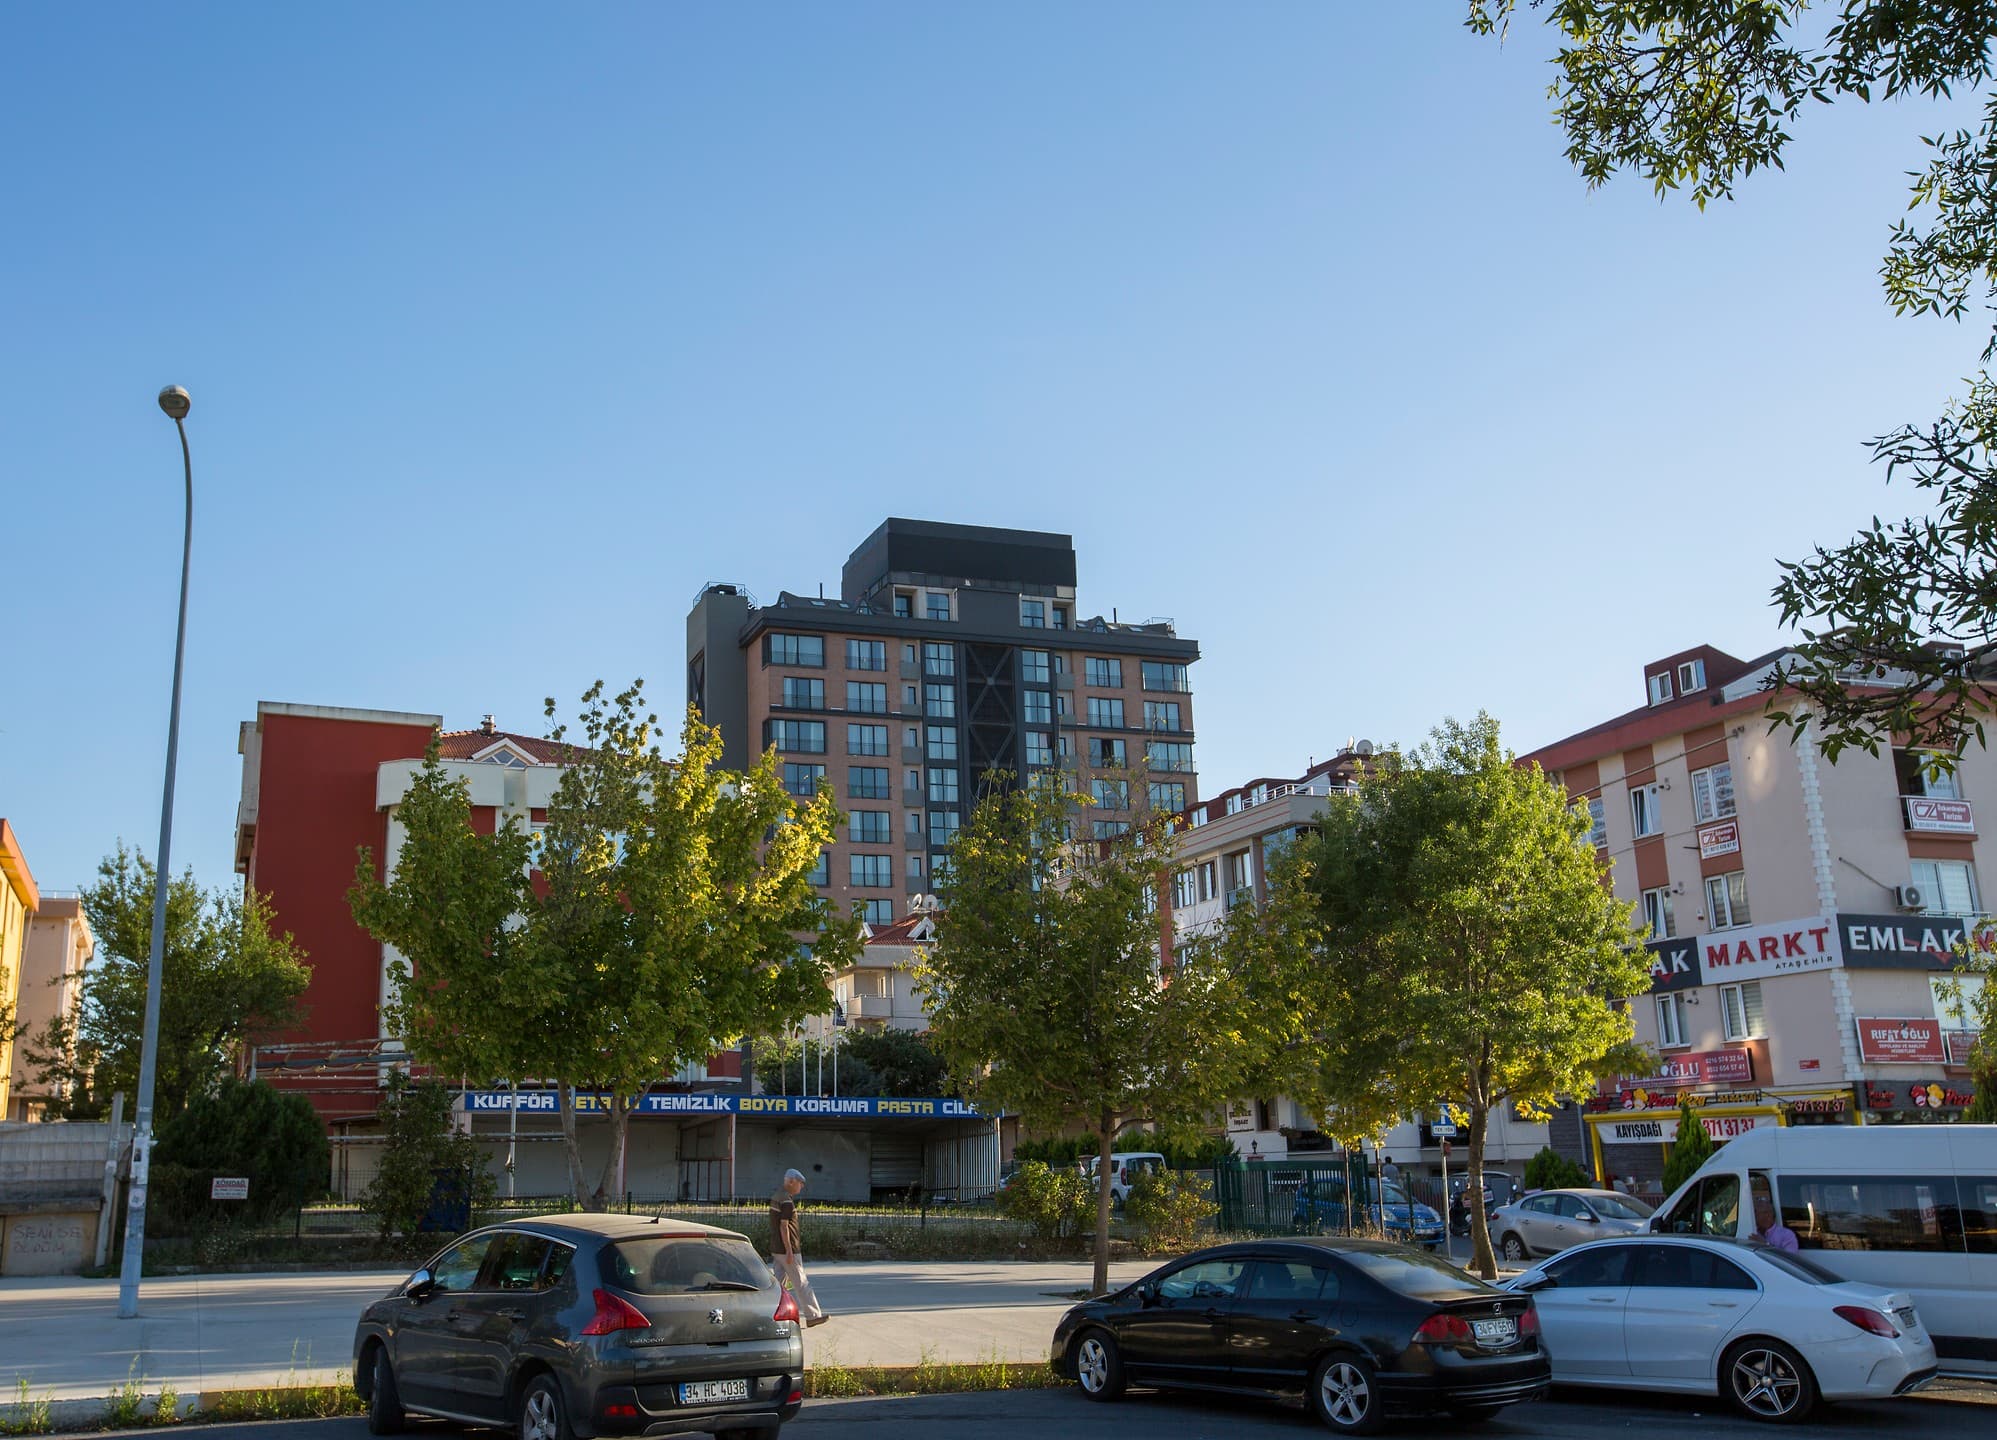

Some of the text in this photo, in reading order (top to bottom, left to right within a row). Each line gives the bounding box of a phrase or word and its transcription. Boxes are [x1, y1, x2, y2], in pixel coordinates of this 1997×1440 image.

[1706, 926, 1829, 969] MARKT
[1847, 925, 1962, 953] EMLAK
[1775, 955, 1833, 970] ATAŞEHİR
[474, 1093, 554, 1108] KUAFÖR
[649, 1094, 731, 1110] TEMİZLİK
[739, 1098, 788, 1111] BOYA
[795, 1099, 869, 1112] KORUMA
[877, 1101, 934, 1114] PASTA
[1615, 1121, 1662, 1141] KAYIŞDAĞI
[1724, 1118, 1739, 1136] 37
[686, 1384, 698, 1398] 34
[704, 1383, 717, 1397] HC
